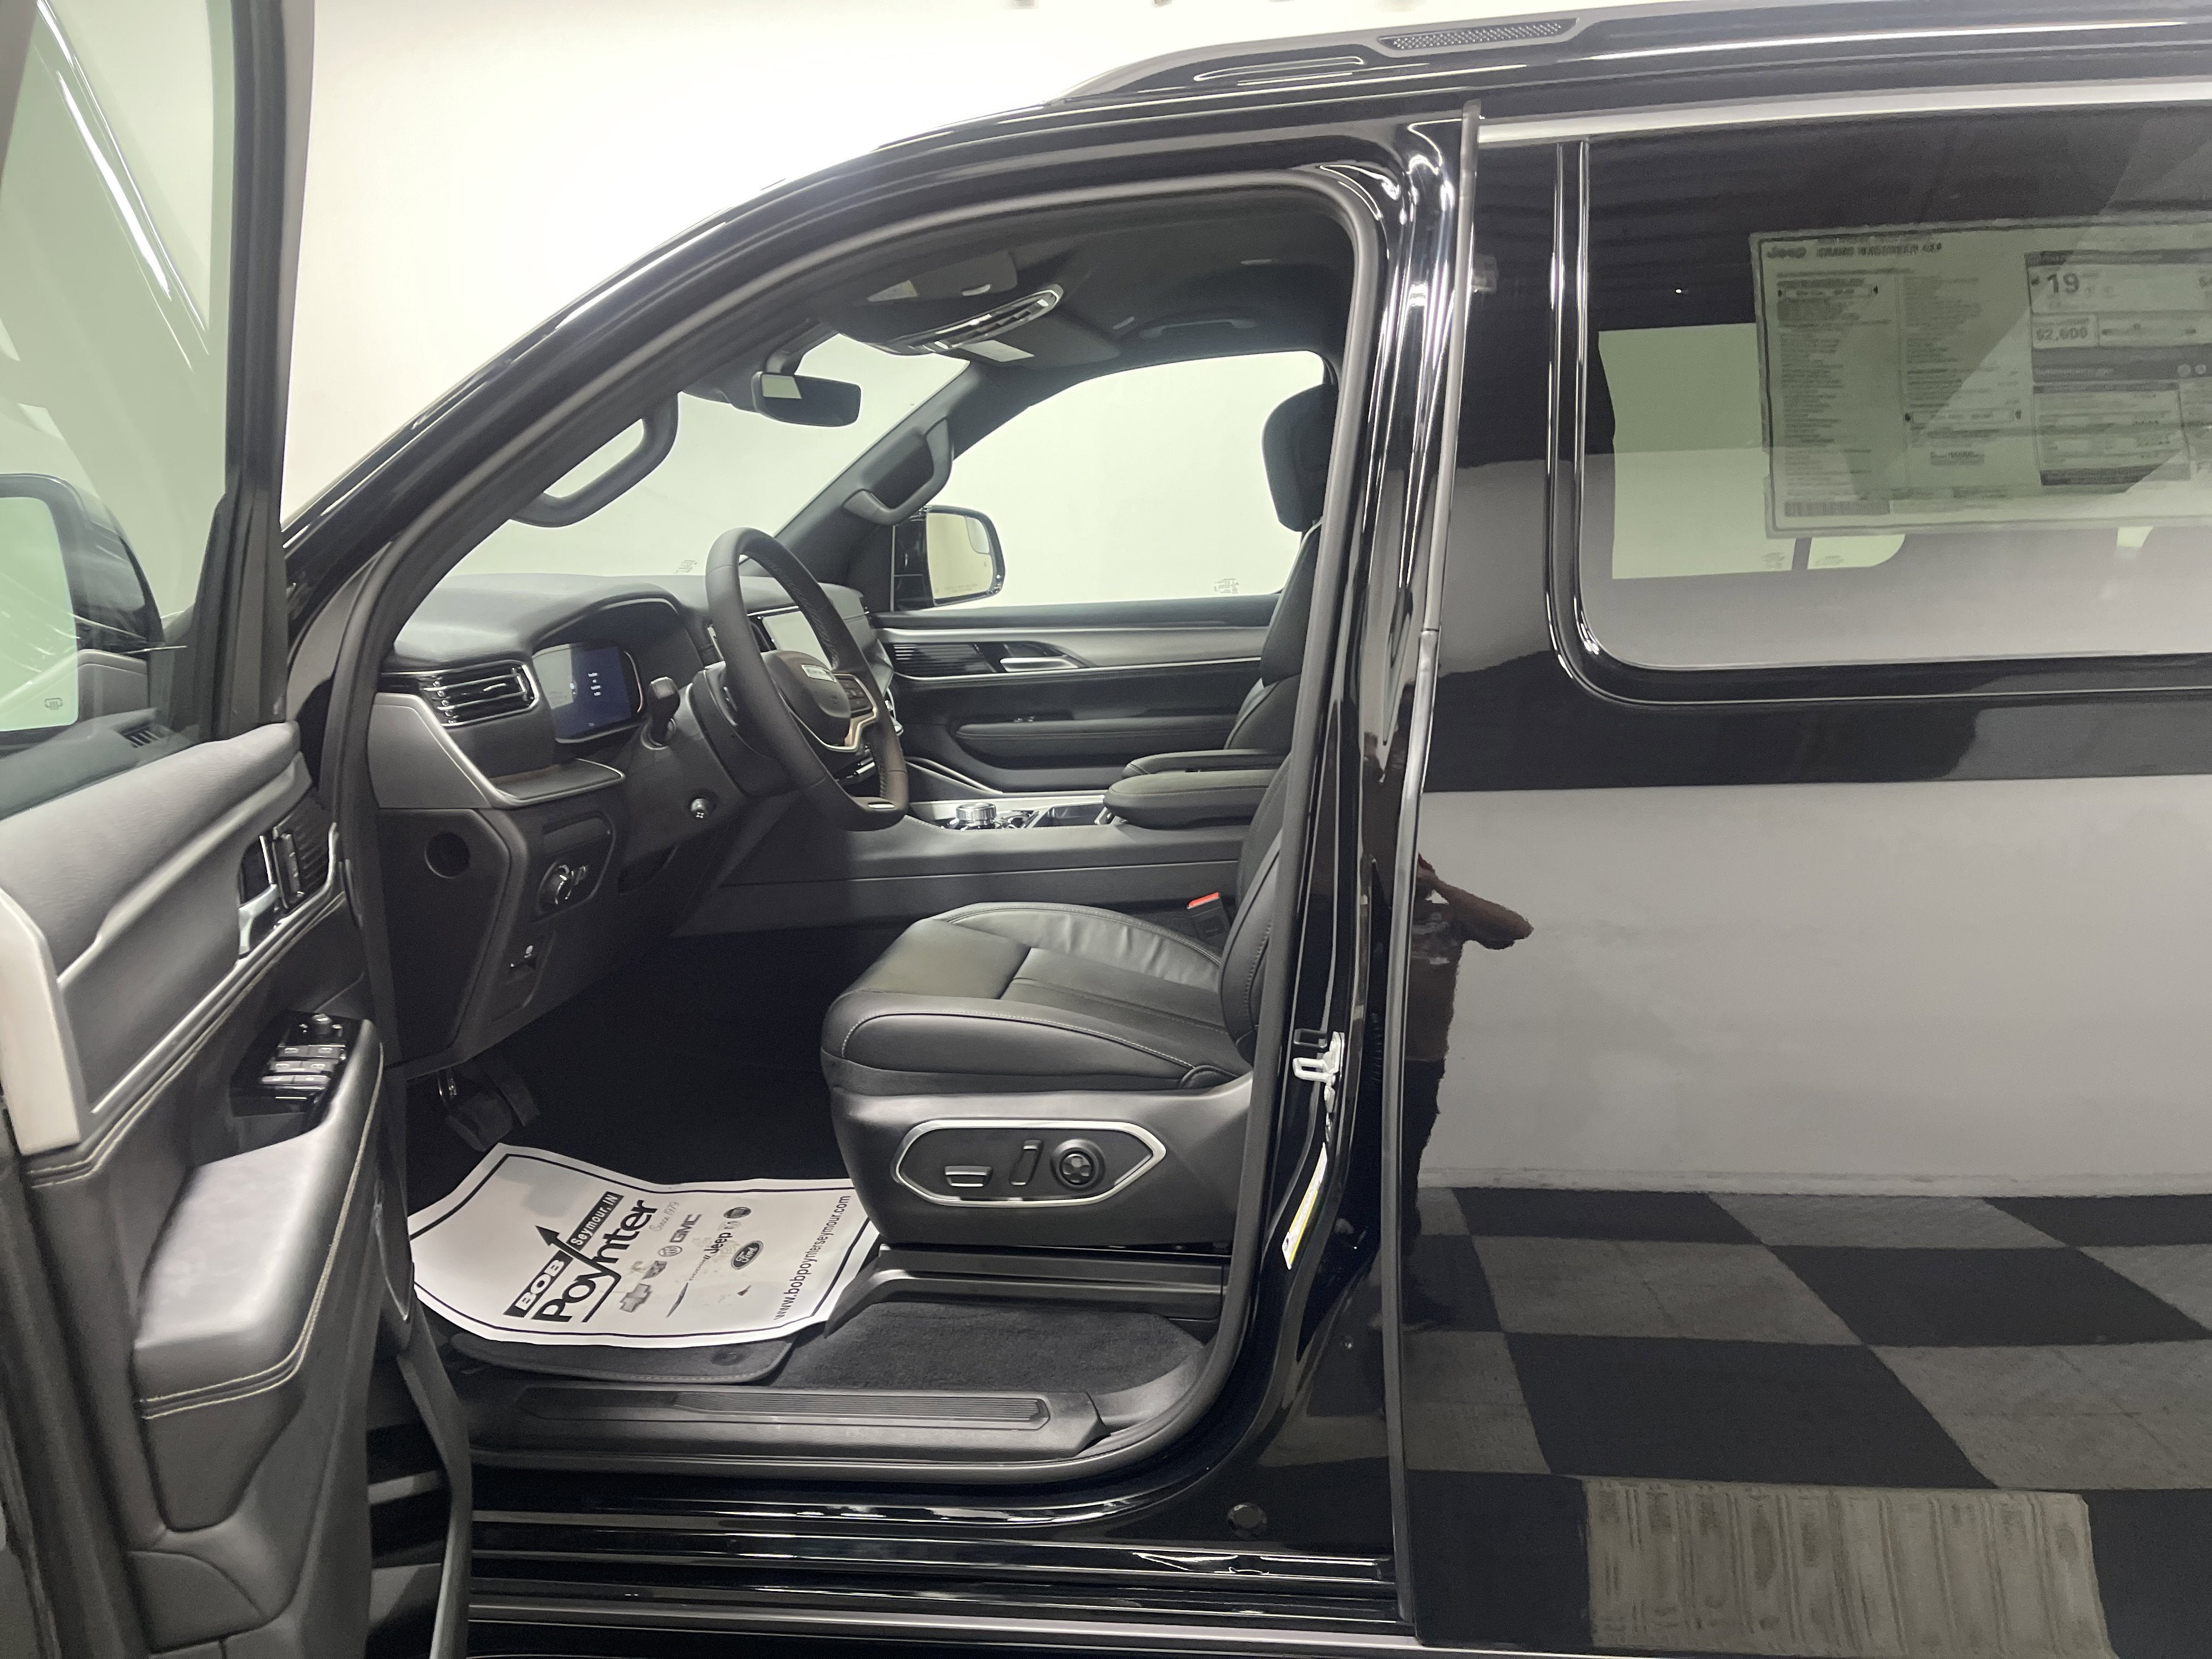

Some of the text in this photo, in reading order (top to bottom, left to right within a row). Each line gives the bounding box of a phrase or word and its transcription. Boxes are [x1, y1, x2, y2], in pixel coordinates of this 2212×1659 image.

[2046, 273, 2079, 294] 19
[602, 1194, 618, 1207] IN
[670, 1214, 703, 1243] GMC
[704, 1232, 733, 1254] Jeep
[531, 1199, 658, 1323] Poynter
[774, 1195, 851, 1321] www.bobpoynterseymour.com
[515, 1259, 565, 1310] BOB
